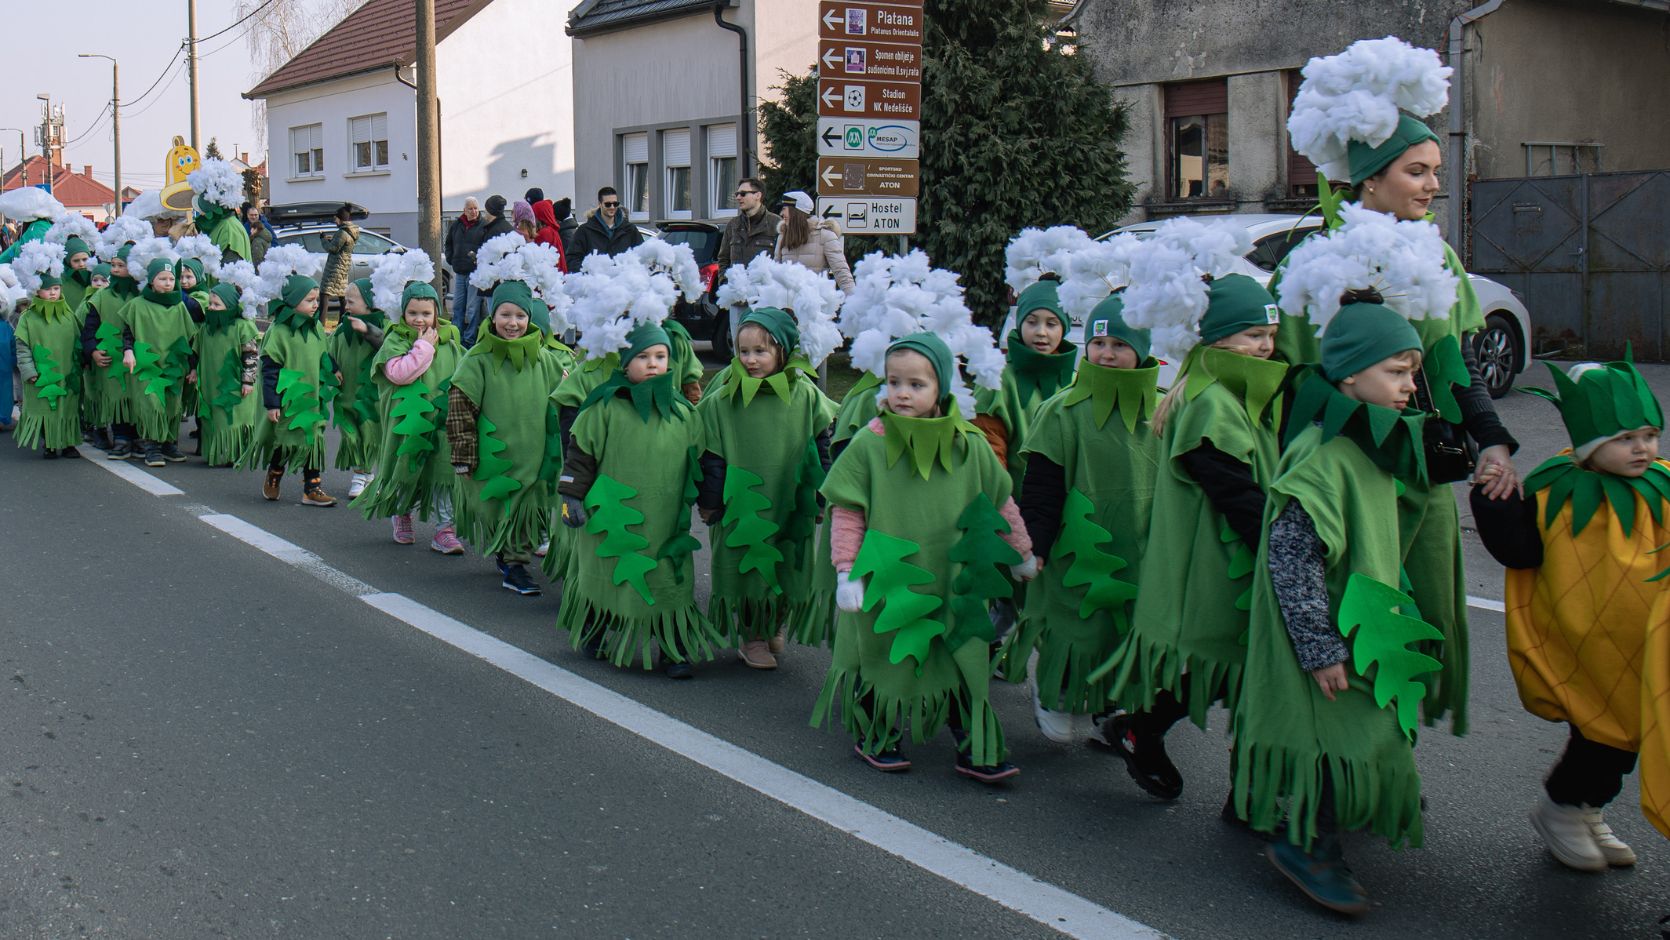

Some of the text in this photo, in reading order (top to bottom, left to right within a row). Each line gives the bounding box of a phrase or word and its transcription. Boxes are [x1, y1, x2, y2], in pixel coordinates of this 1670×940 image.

[877, 10, 913, 26] Platana
[870, 26, 892, 35] Platanus
[875, 49, 894, 61] Spomen
[882, 88, 906, 99] Stadion
[873, 102, 912, 113] NK Nedelišće
[879, 181, 900, 189] ATON
[871, 202, 902, 213] Hostel
[873, 218, 900, 229] ATON
